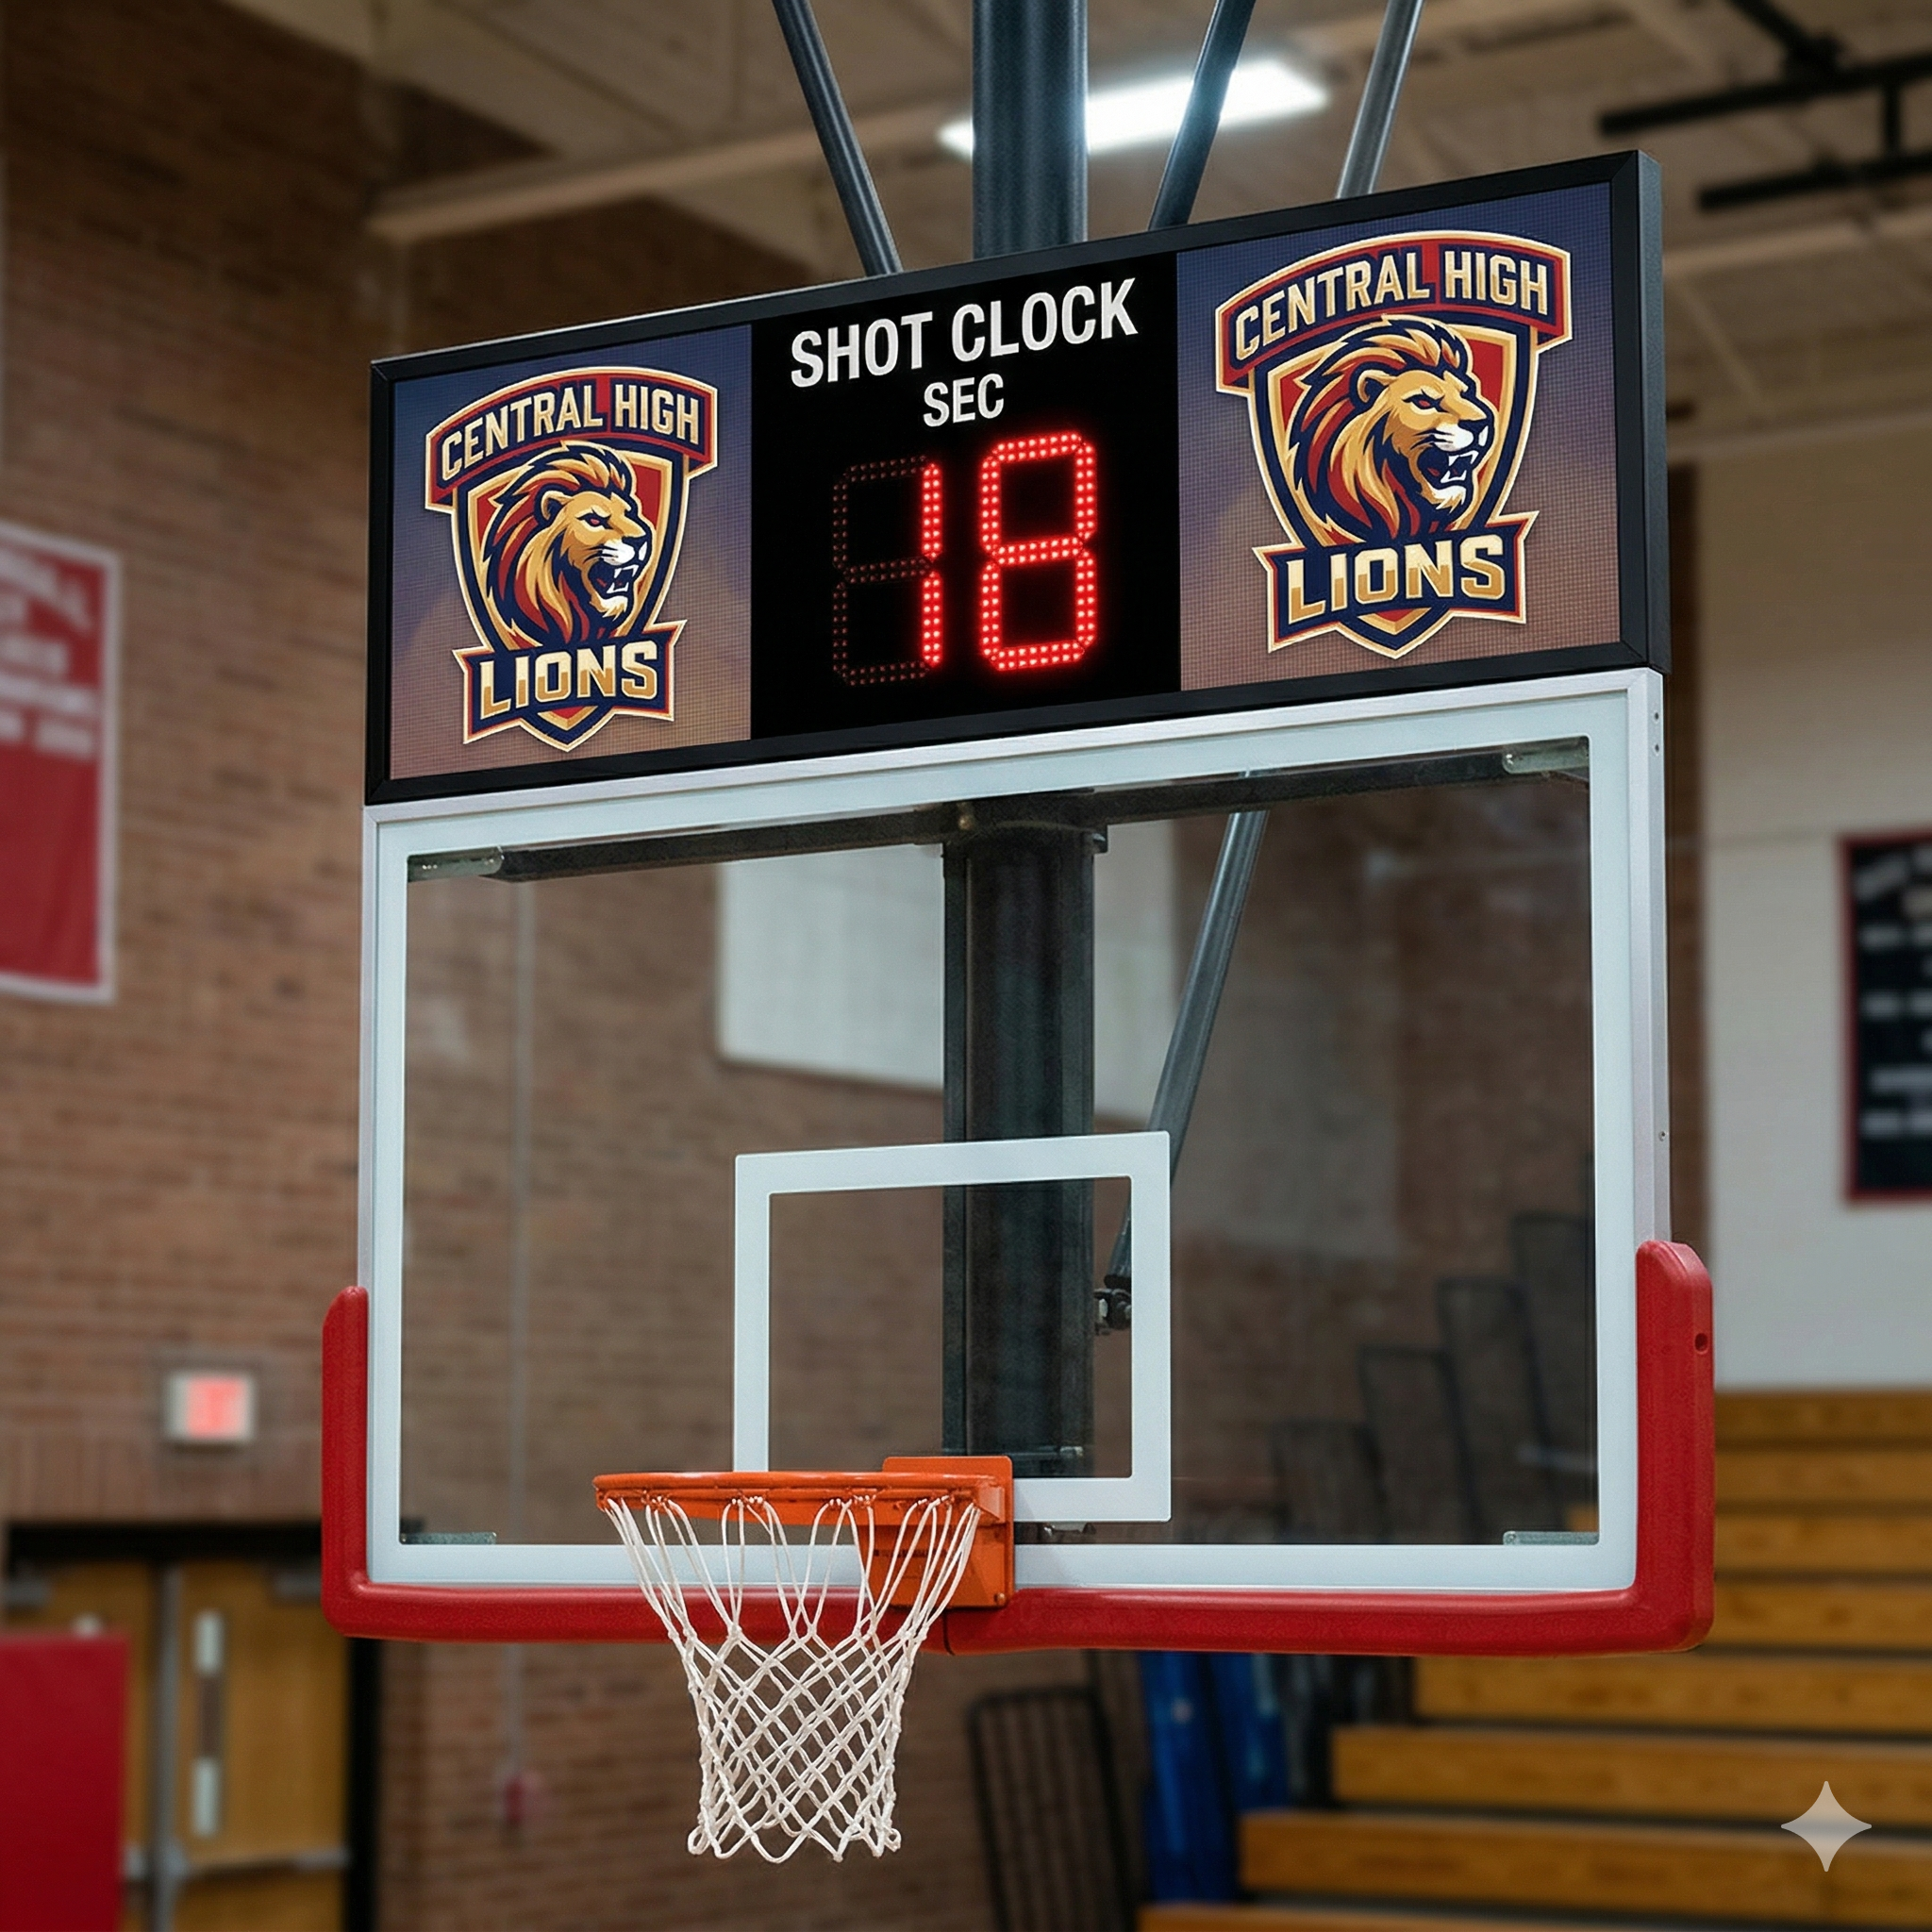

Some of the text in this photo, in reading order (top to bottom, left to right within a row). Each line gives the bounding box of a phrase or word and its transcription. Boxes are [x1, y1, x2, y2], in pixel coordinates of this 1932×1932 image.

[791, 277, 1138, 388] SHOT CLOCK
[1235, 250, 1548, 361] CENTRAL HIGH
[441, 384, 699, 482] CENTRAL HIGH
[923, 374, 1005, 427] SEC
[922, 430, 1097, 672] 18
[1286, 534, 1507, 625] LIONS
[479, 641, 658, 720] LIONS
